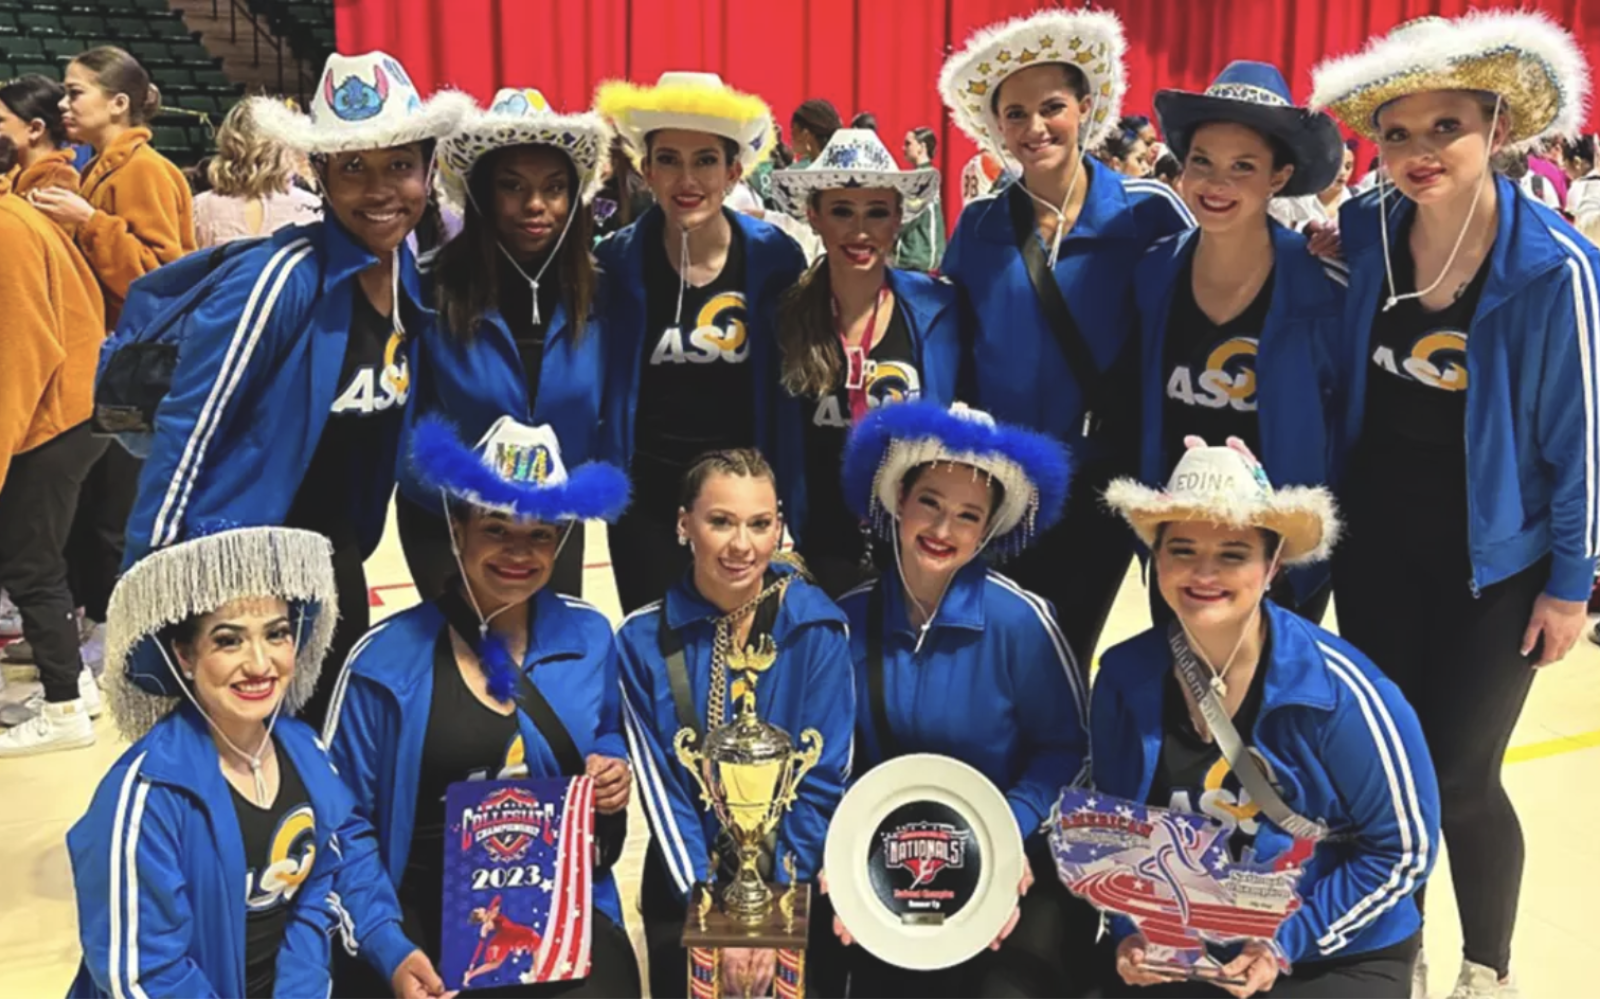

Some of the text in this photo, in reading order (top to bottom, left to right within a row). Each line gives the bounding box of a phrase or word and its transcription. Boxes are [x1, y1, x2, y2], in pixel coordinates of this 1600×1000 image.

[649, 326, 750, 365] ASU
[1176, 472, 1236, 491] EDINA
[462, 803, 555, 851] COLLEGIATE
[1061, 812, 1154, 839] AMERICAN
[890, 839, 960, 864] NATIONALS
[472, 865, 541, 890] 2023
